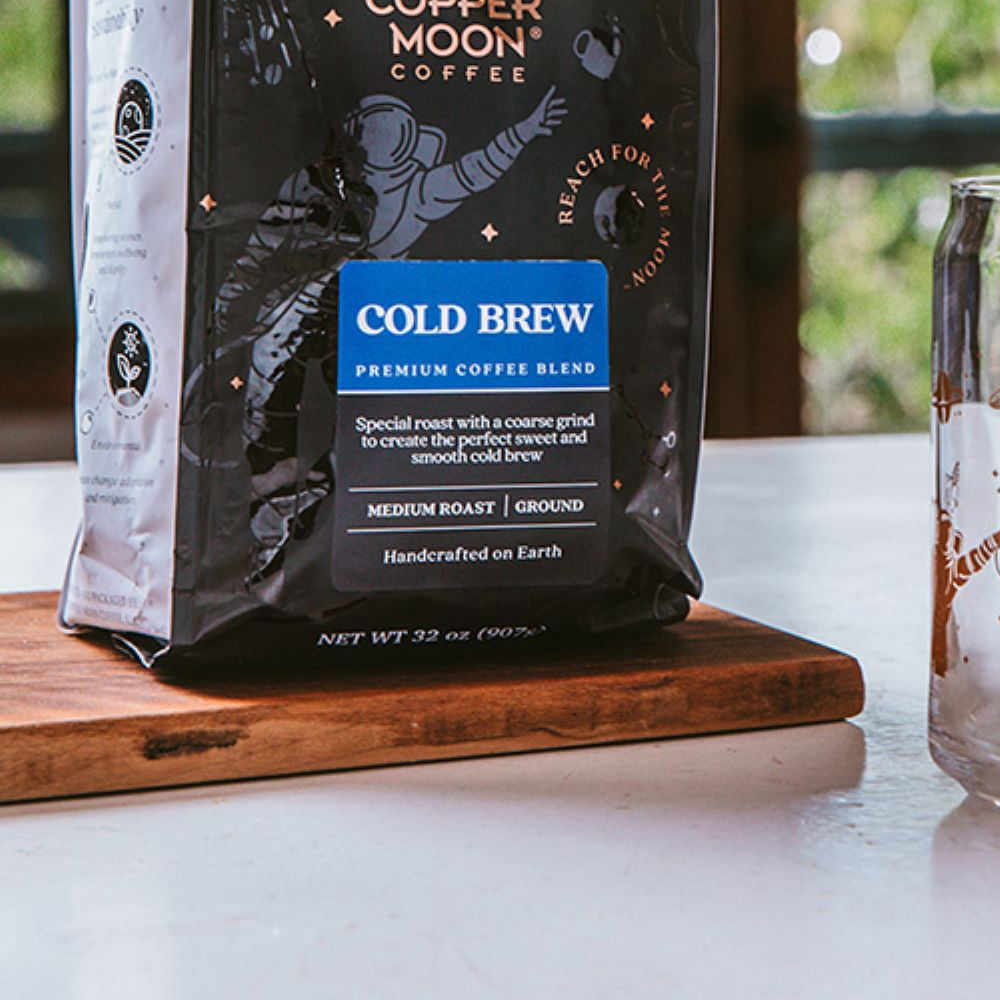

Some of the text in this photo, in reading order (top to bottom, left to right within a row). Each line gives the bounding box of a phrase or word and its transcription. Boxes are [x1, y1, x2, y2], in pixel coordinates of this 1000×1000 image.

[390, 63, 526, 83] COFFEE
[558, 148, 605, 225] REACH
[611, 143, 651, 170] FOR
[356, 302, 594, 336] COLD BREW
[355, 362, 596, 378] PREMIUM COFFEE BLEND
[355, 413, 595, 434] Special roast with a coarse grind
[361, 430, 588, 450] to create the perfect sweet and
[411, 449, 545, 464] smooth cold brew
[367, 501, 496, 518] MEDIUM ROAST
[515, 499, 585, 514] GROUND
[383, 544, 563, 565] Handcrafted on Earth
[317, 632, 366, 647] NET
[370, 630, 408, 645] WT
[411, 629, 439, 643] 32
[445, 630, 471, 642] oz
